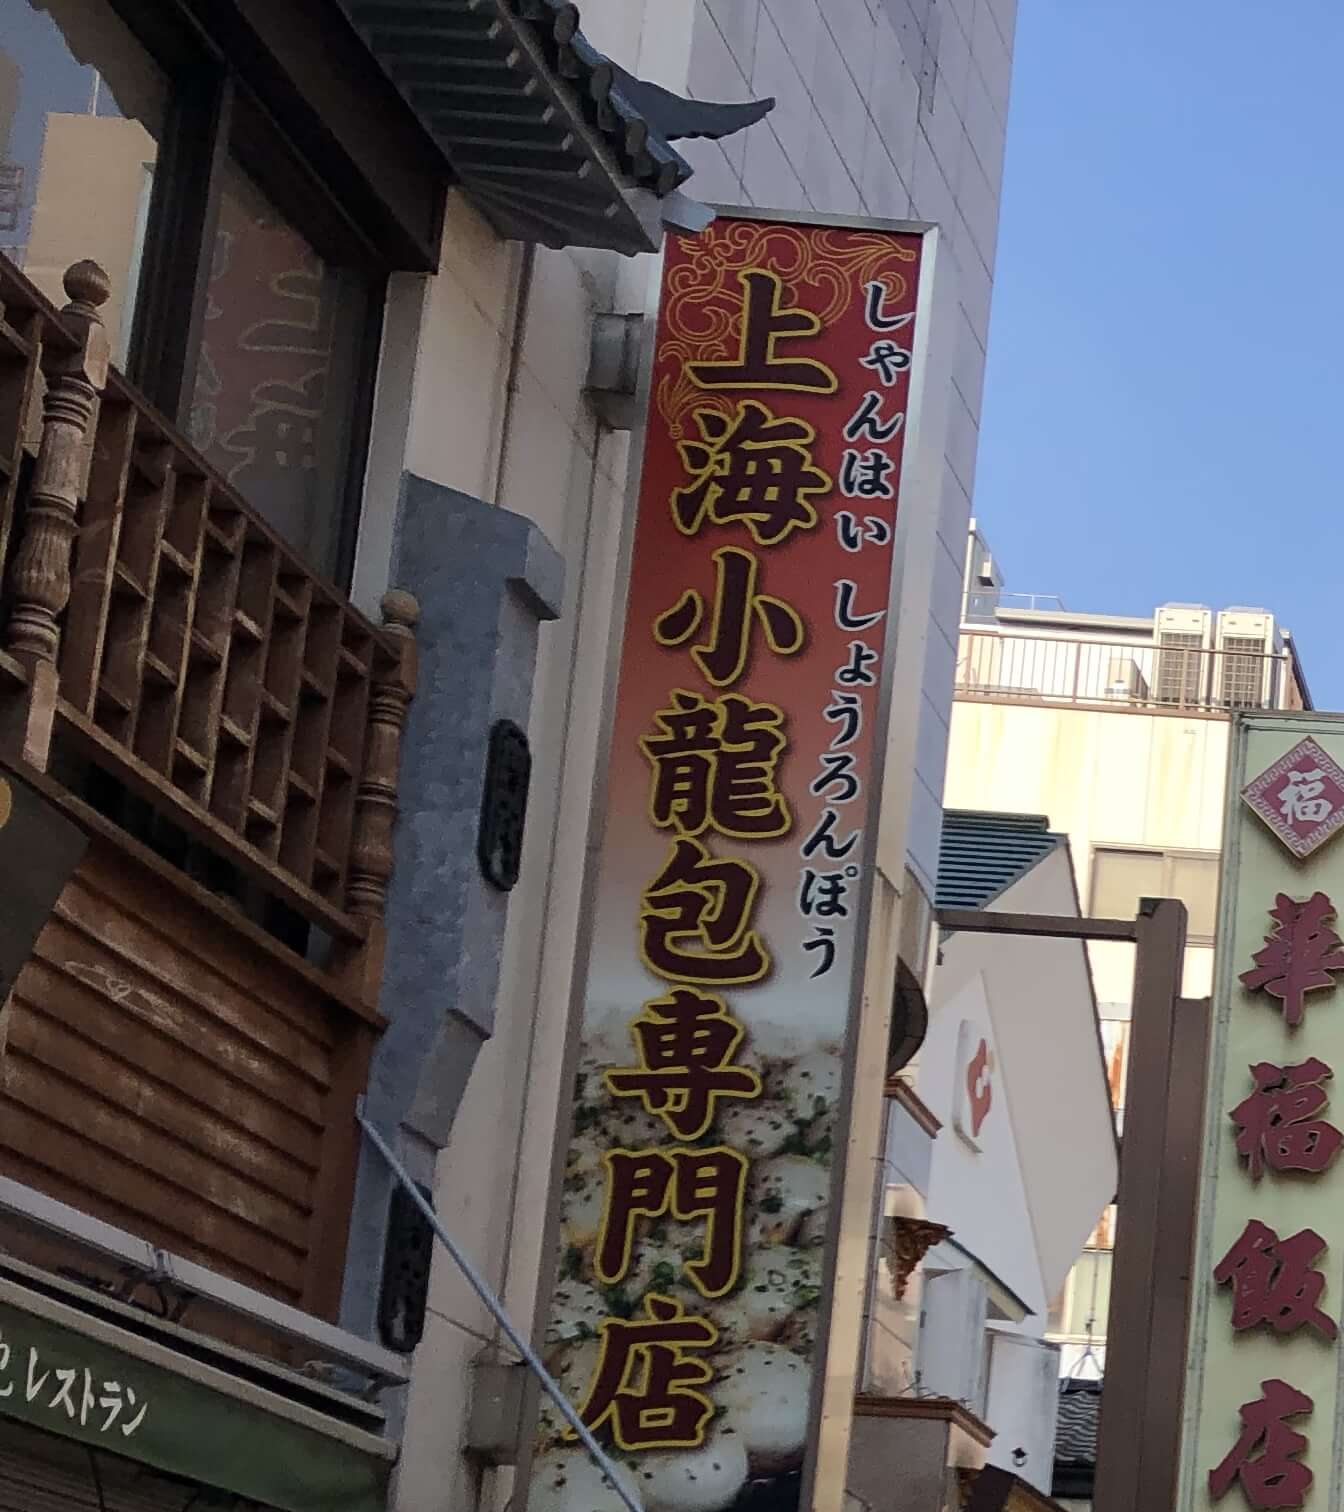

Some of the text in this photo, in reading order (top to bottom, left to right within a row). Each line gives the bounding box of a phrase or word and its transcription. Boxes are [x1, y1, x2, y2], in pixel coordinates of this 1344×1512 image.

[834, 281, 917, 551] しゃんはい
[563, 268, 839, 1451] 上海小龍包専門店
[1277, 768, 1334, 825] 福
